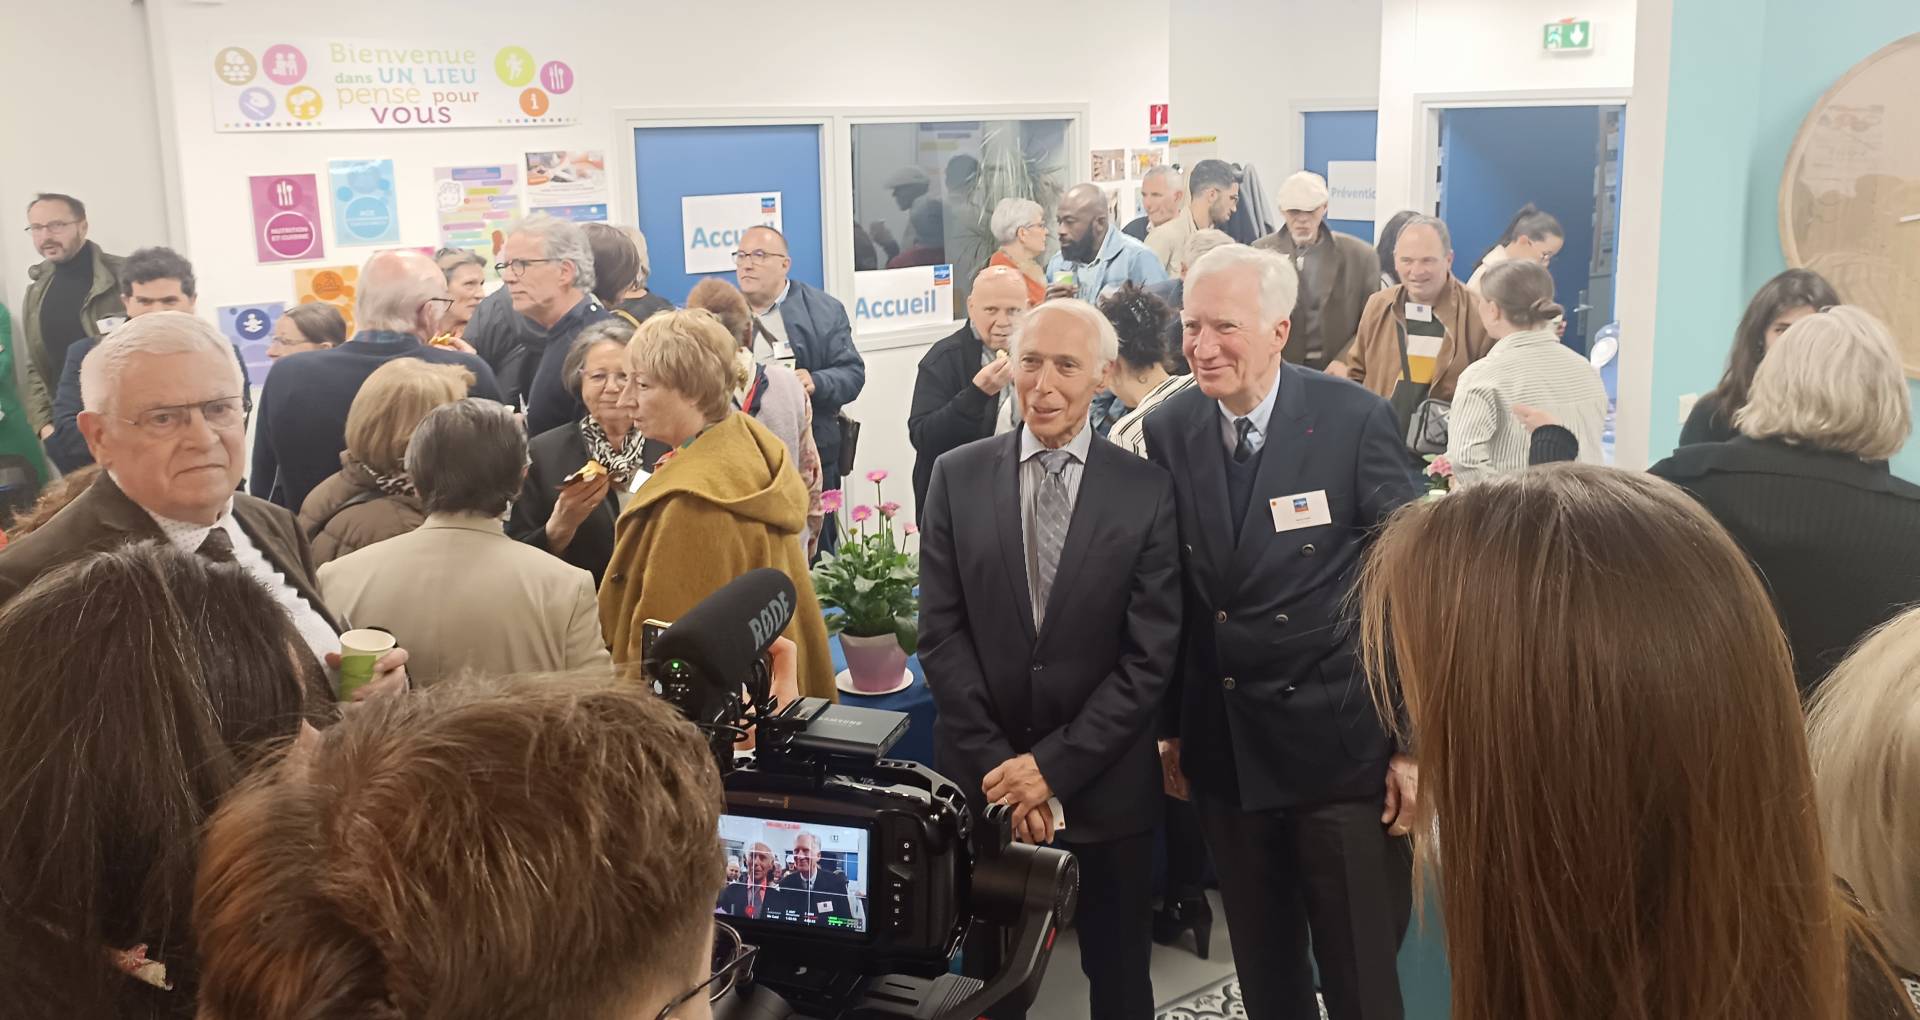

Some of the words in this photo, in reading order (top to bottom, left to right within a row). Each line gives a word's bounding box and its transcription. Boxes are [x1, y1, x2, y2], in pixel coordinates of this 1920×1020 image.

[329, 42, 477, 65] Bienvenue
[335, 72, 373, 84] dans
[377, 67, 413, 85] UN
[423, 67, 478, 84] LIEU
[336, 87, 421, 110] pense
[432, 91, 480, 106] pour
[855, 288, 936, 319] Accueil
